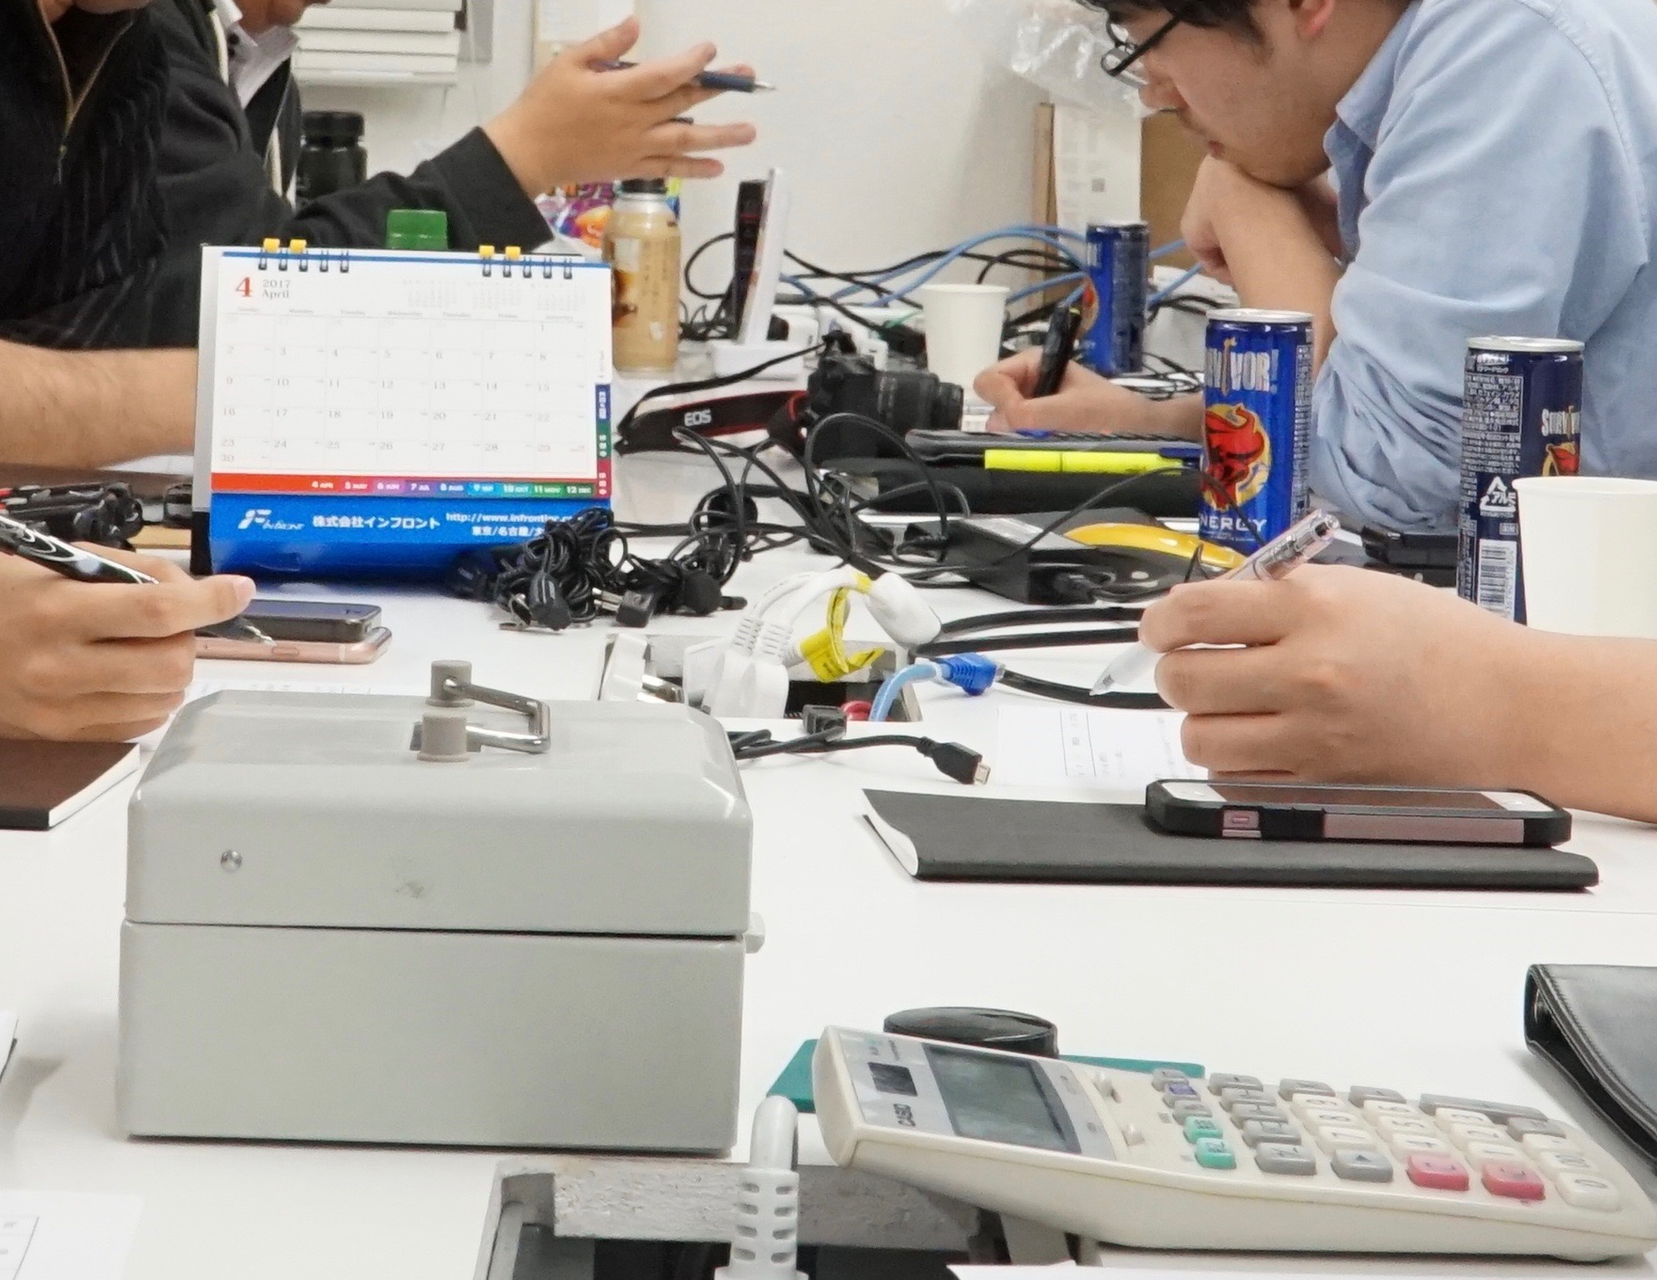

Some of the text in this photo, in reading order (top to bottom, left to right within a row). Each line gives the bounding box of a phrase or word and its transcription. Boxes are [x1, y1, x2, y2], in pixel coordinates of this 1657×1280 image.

[235, 276, 291, 298] 4 2017
[261, 288, 290, 300] April
[226, 376, 550, 392] 9 10 11 12 13 14 15
[222, 407, 550, 422] 16 17 18 19 20 21 22
[683, 407, 712, 427] EOS
[221, 438, 551, 452] 23 24 25 26 27 28 29
[312, 514, 441, 530] 株式会社インフロント
